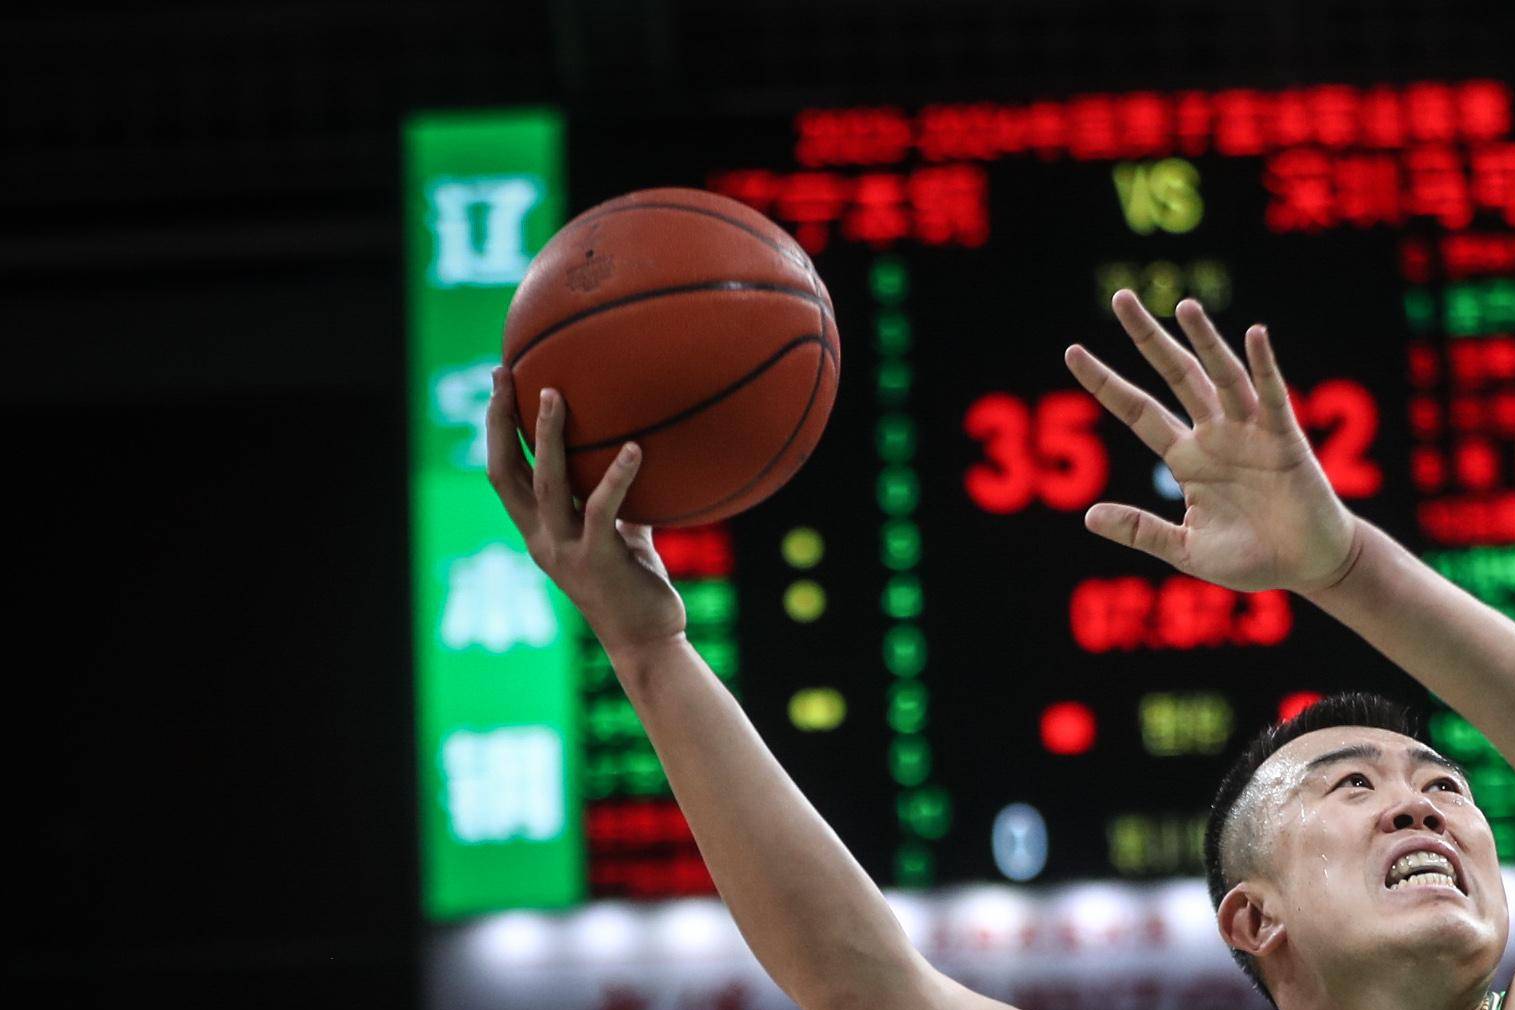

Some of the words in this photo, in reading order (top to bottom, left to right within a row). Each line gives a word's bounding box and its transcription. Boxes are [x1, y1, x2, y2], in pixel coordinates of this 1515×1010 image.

[1114, 158, 1203, 234] VS
[964, 392, 1110, 514] 35
[1288, 378, 1384, 498] 2
